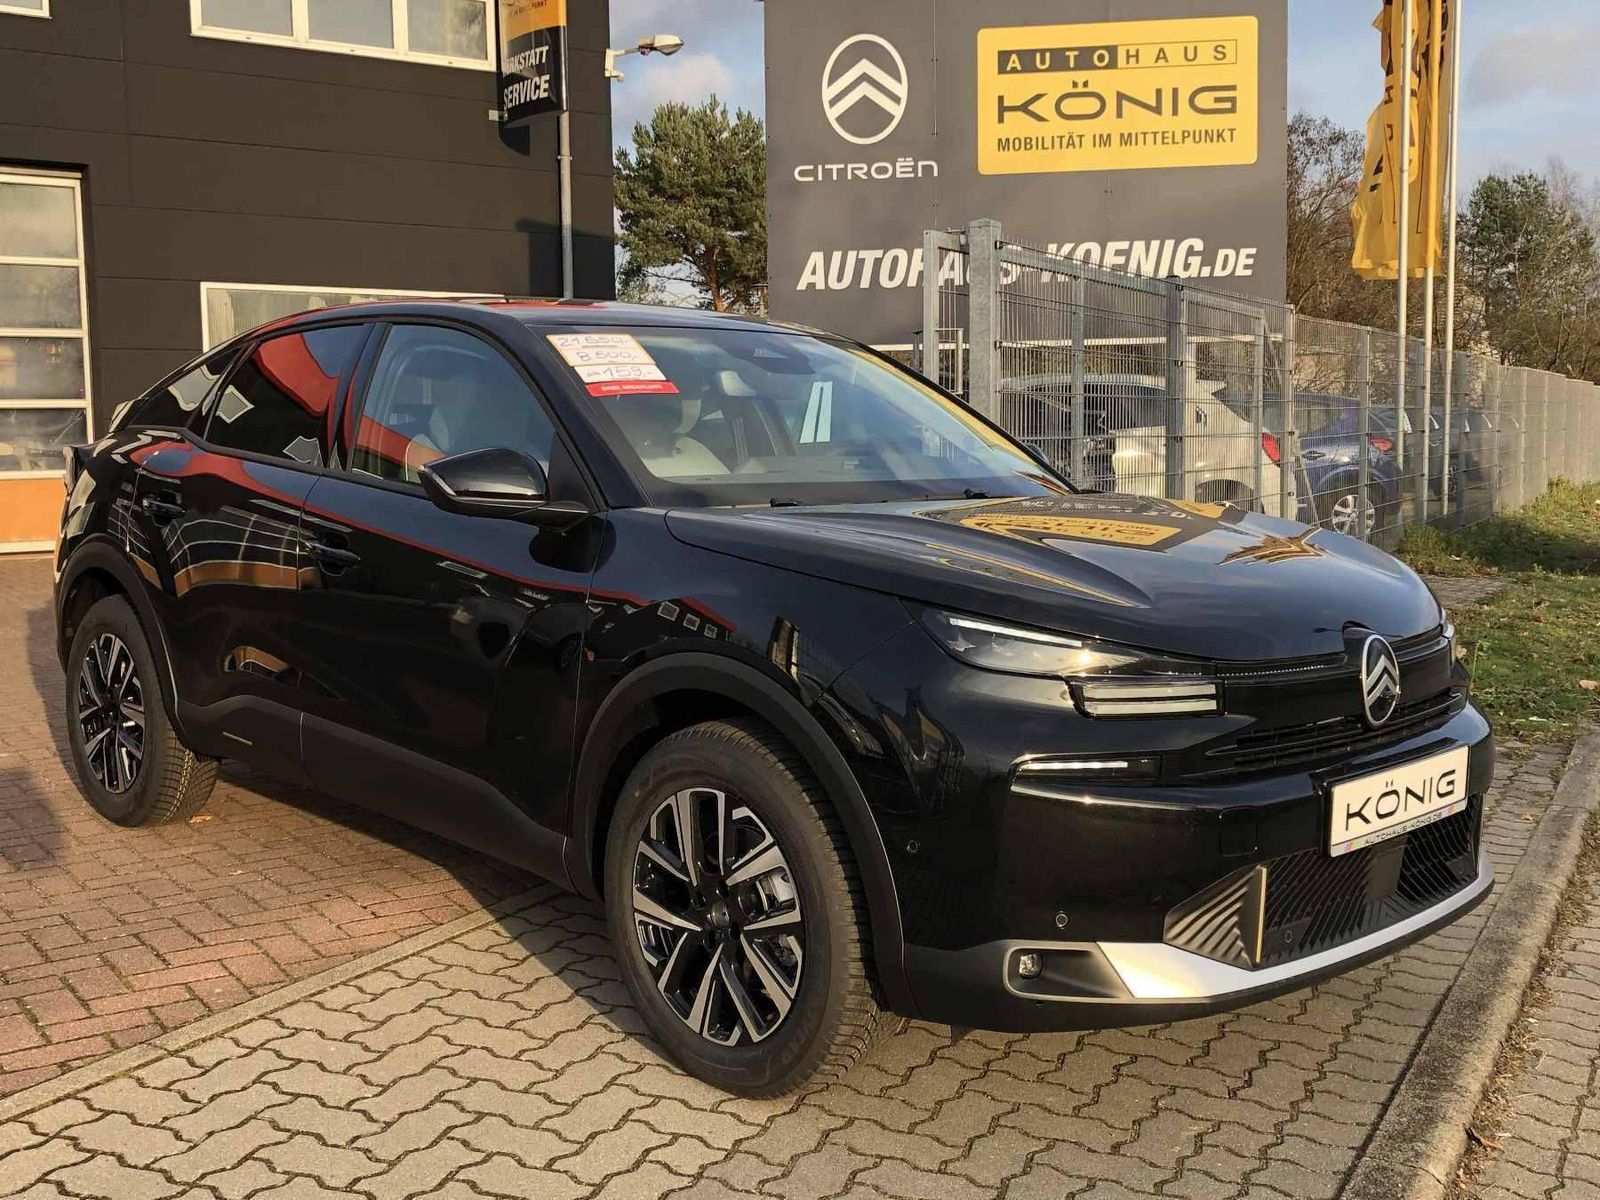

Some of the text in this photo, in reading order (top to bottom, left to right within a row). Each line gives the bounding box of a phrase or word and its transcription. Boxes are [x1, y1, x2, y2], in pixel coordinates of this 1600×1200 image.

[1006, 44, 1228, 71] AUTOHAUS
[503, 74, 550, 110] SERVICE
[997, 79, 1238, 124] KÖNIG
[997, 127, 1237, 152] MOBILITÄT IM MITTELPUNKT
[1345, 769, 1456, 832] KÖNIG
